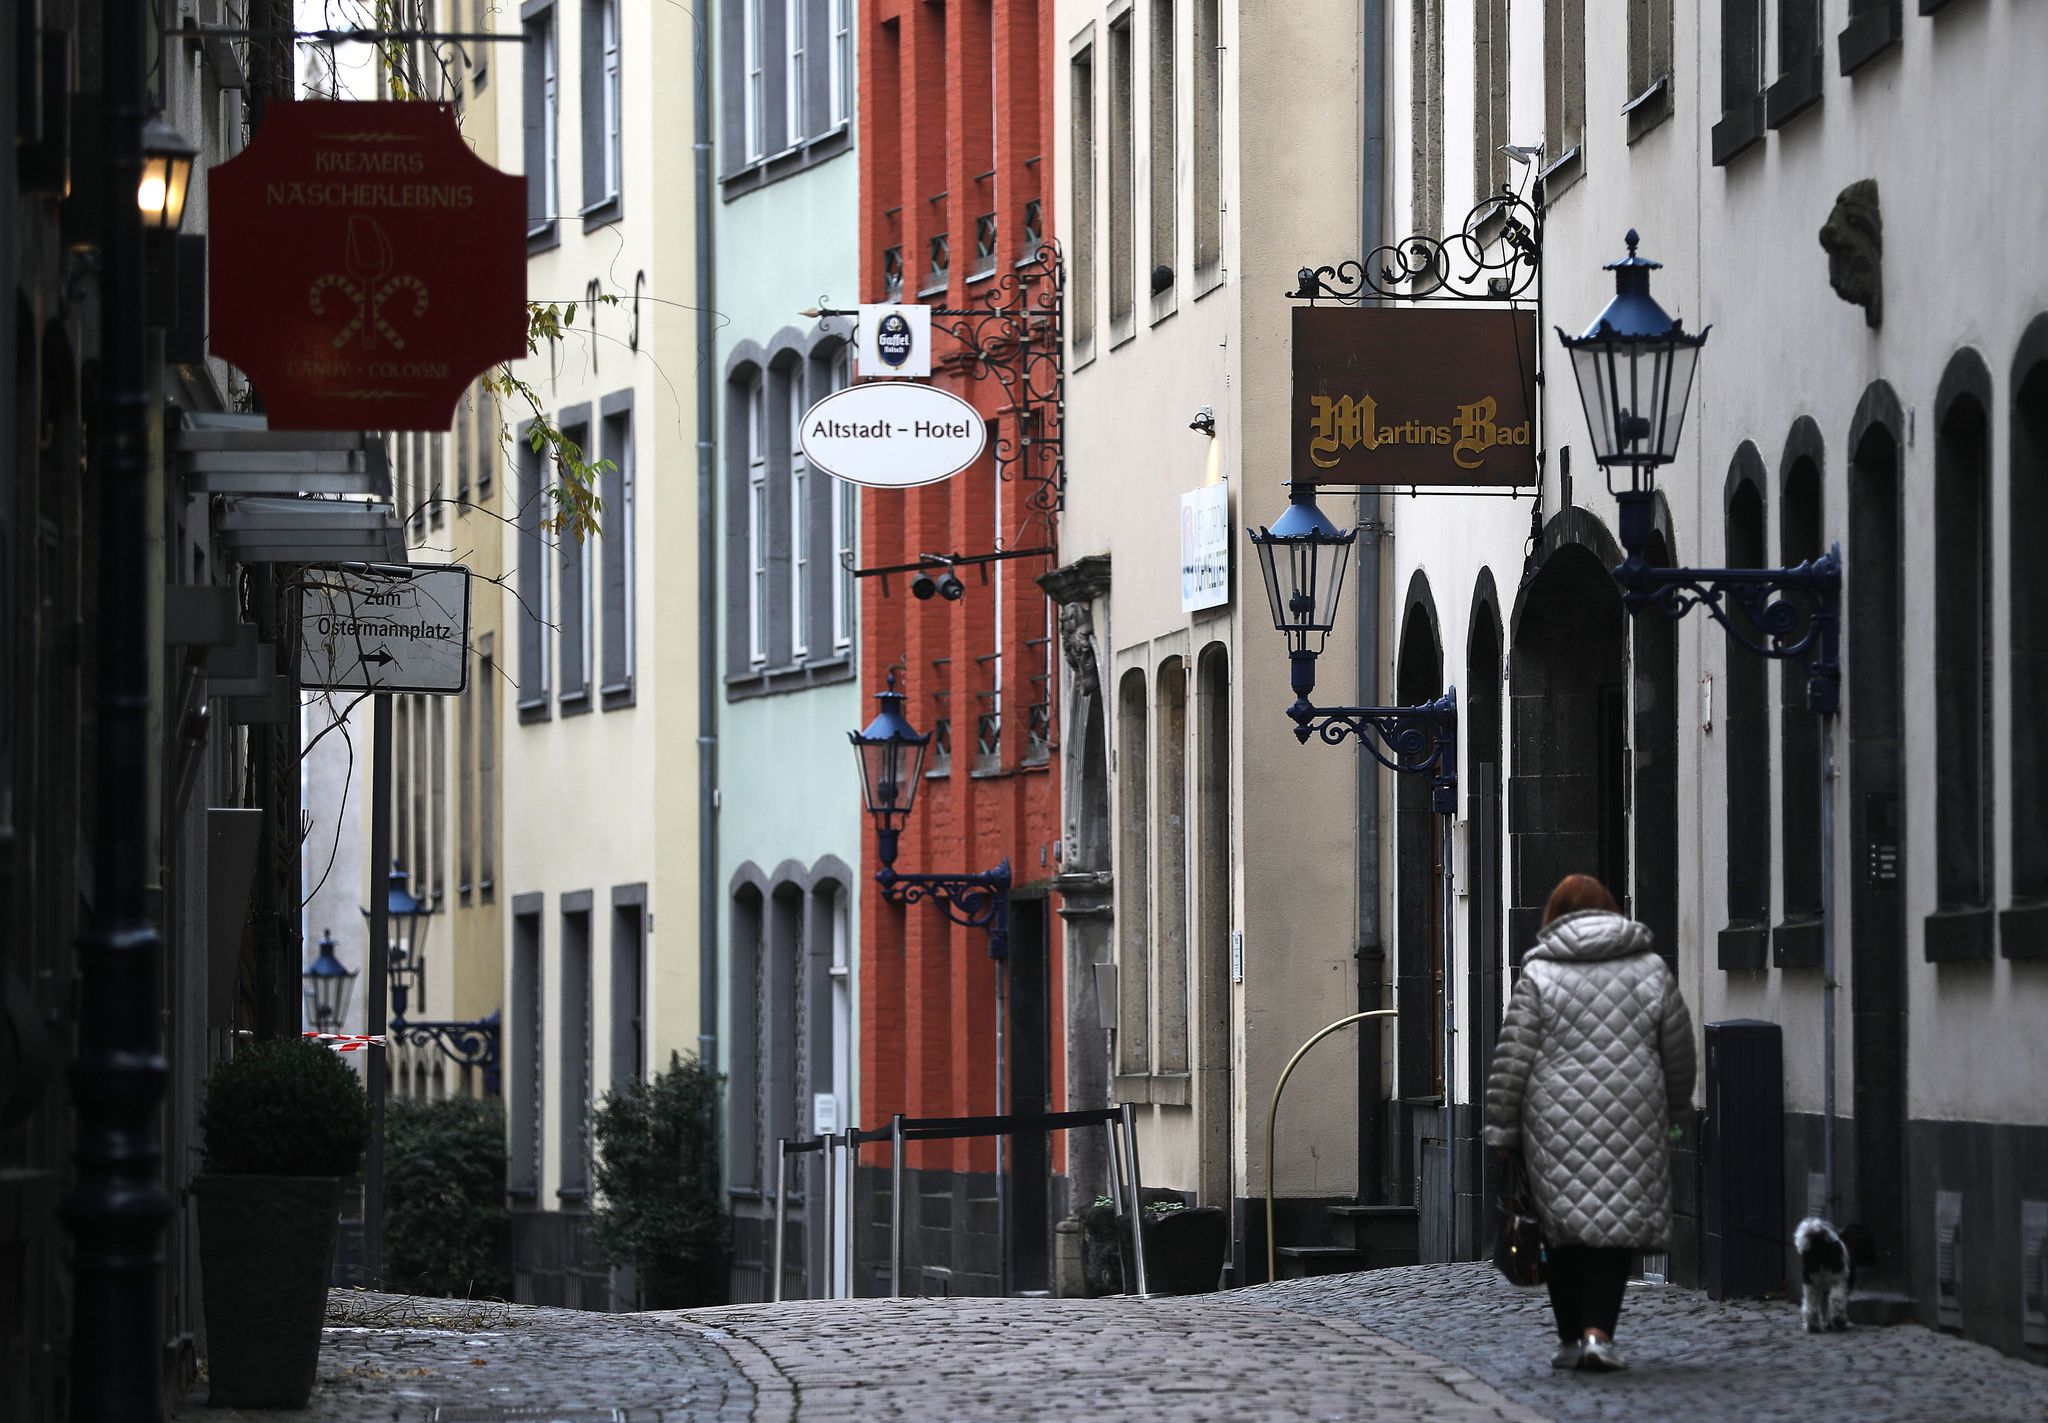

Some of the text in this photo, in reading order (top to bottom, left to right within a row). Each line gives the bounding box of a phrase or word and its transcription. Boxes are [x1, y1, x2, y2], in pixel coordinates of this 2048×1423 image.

[315, 152, 424, 173] KREMERS
[879, 333, 910, 347] Gaffel
[287, 361, 450, 379] CANDY COLOGNE
[812, 419, 892, 438] Altstadt
[914, 419, 970, 438] Hotel
[1310, 394, 1530, 469] Martins Bad
[364, 587, 401, 606] Zum
[318, 617, 451, 642] Ostermannplatz
